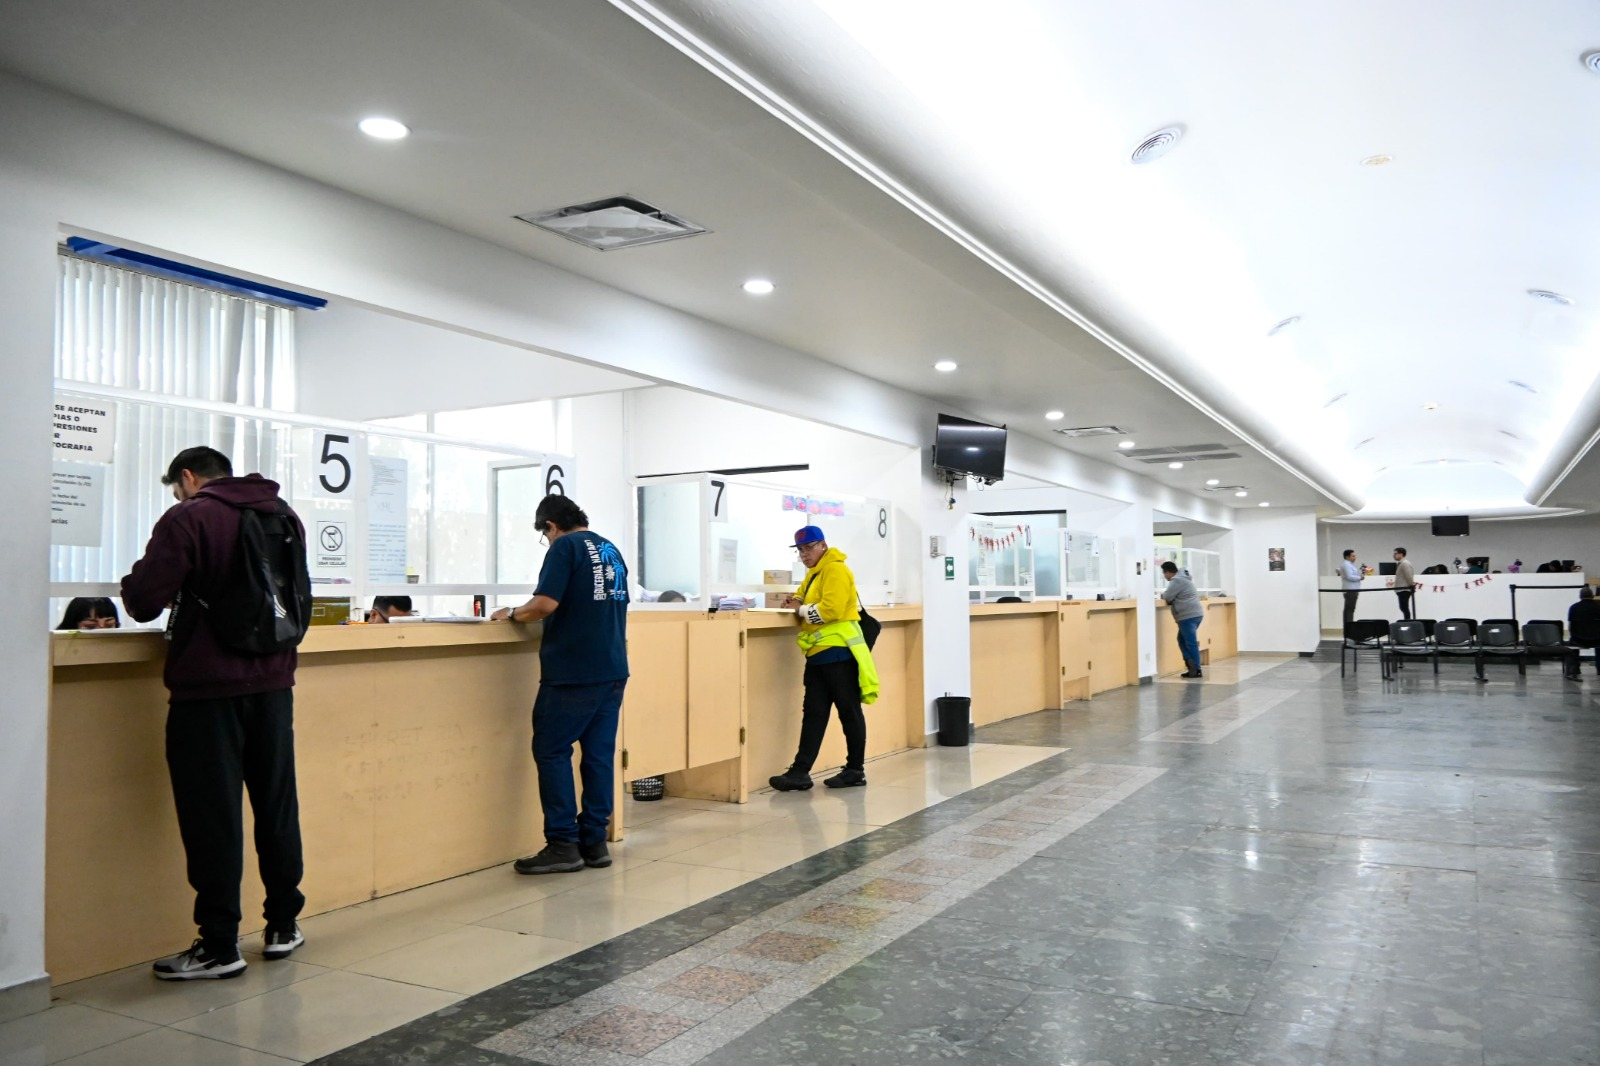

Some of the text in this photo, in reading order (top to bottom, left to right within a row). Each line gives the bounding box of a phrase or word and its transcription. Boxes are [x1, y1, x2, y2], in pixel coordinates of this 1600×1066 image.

[67, 406, 106, 416] ACEPTAN
[52, 441, 93, 451] OGRAFIA
[319, 434, 351, 493] 5
[545, 464, 564, 497] 6
[711, 480, 725, 517] 7
[878, 508, 887, 538] 8
